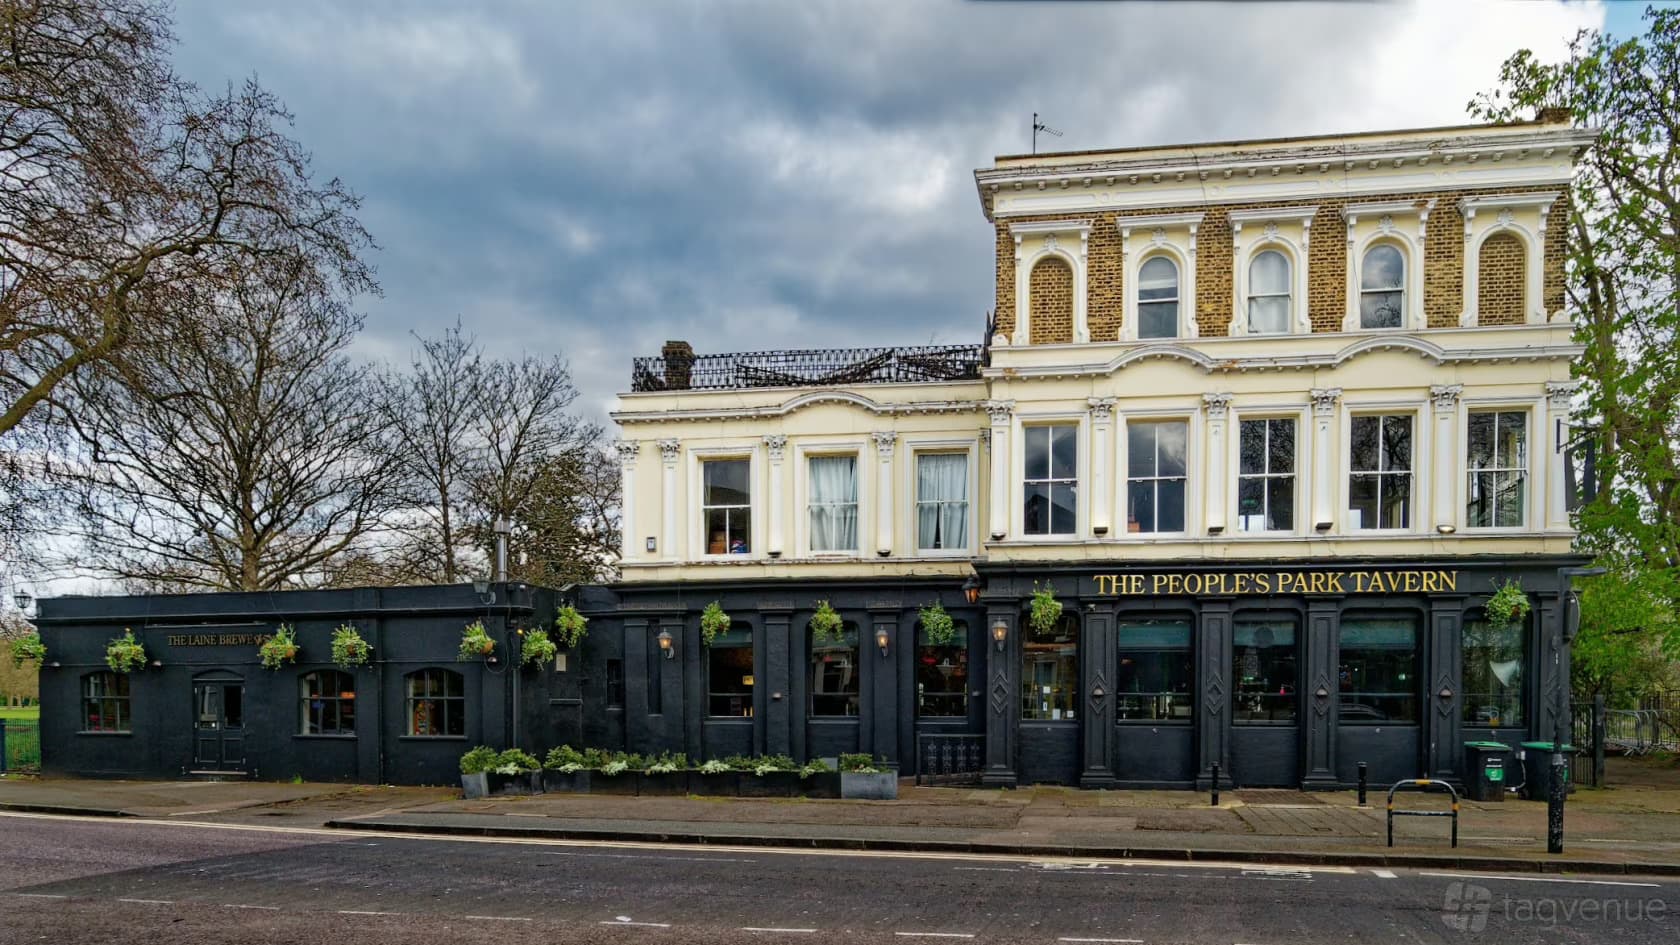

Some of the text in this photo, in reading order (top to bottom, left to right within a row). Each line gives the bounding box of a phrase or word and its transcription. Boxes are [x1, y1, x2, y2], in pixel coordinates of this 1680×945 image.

[1093, 571, 1458, 595] THE PEOPLE'S PARK TAVERN
[168, 635, 187, 646] THE
[189, 635, 217, 646] LAINE
